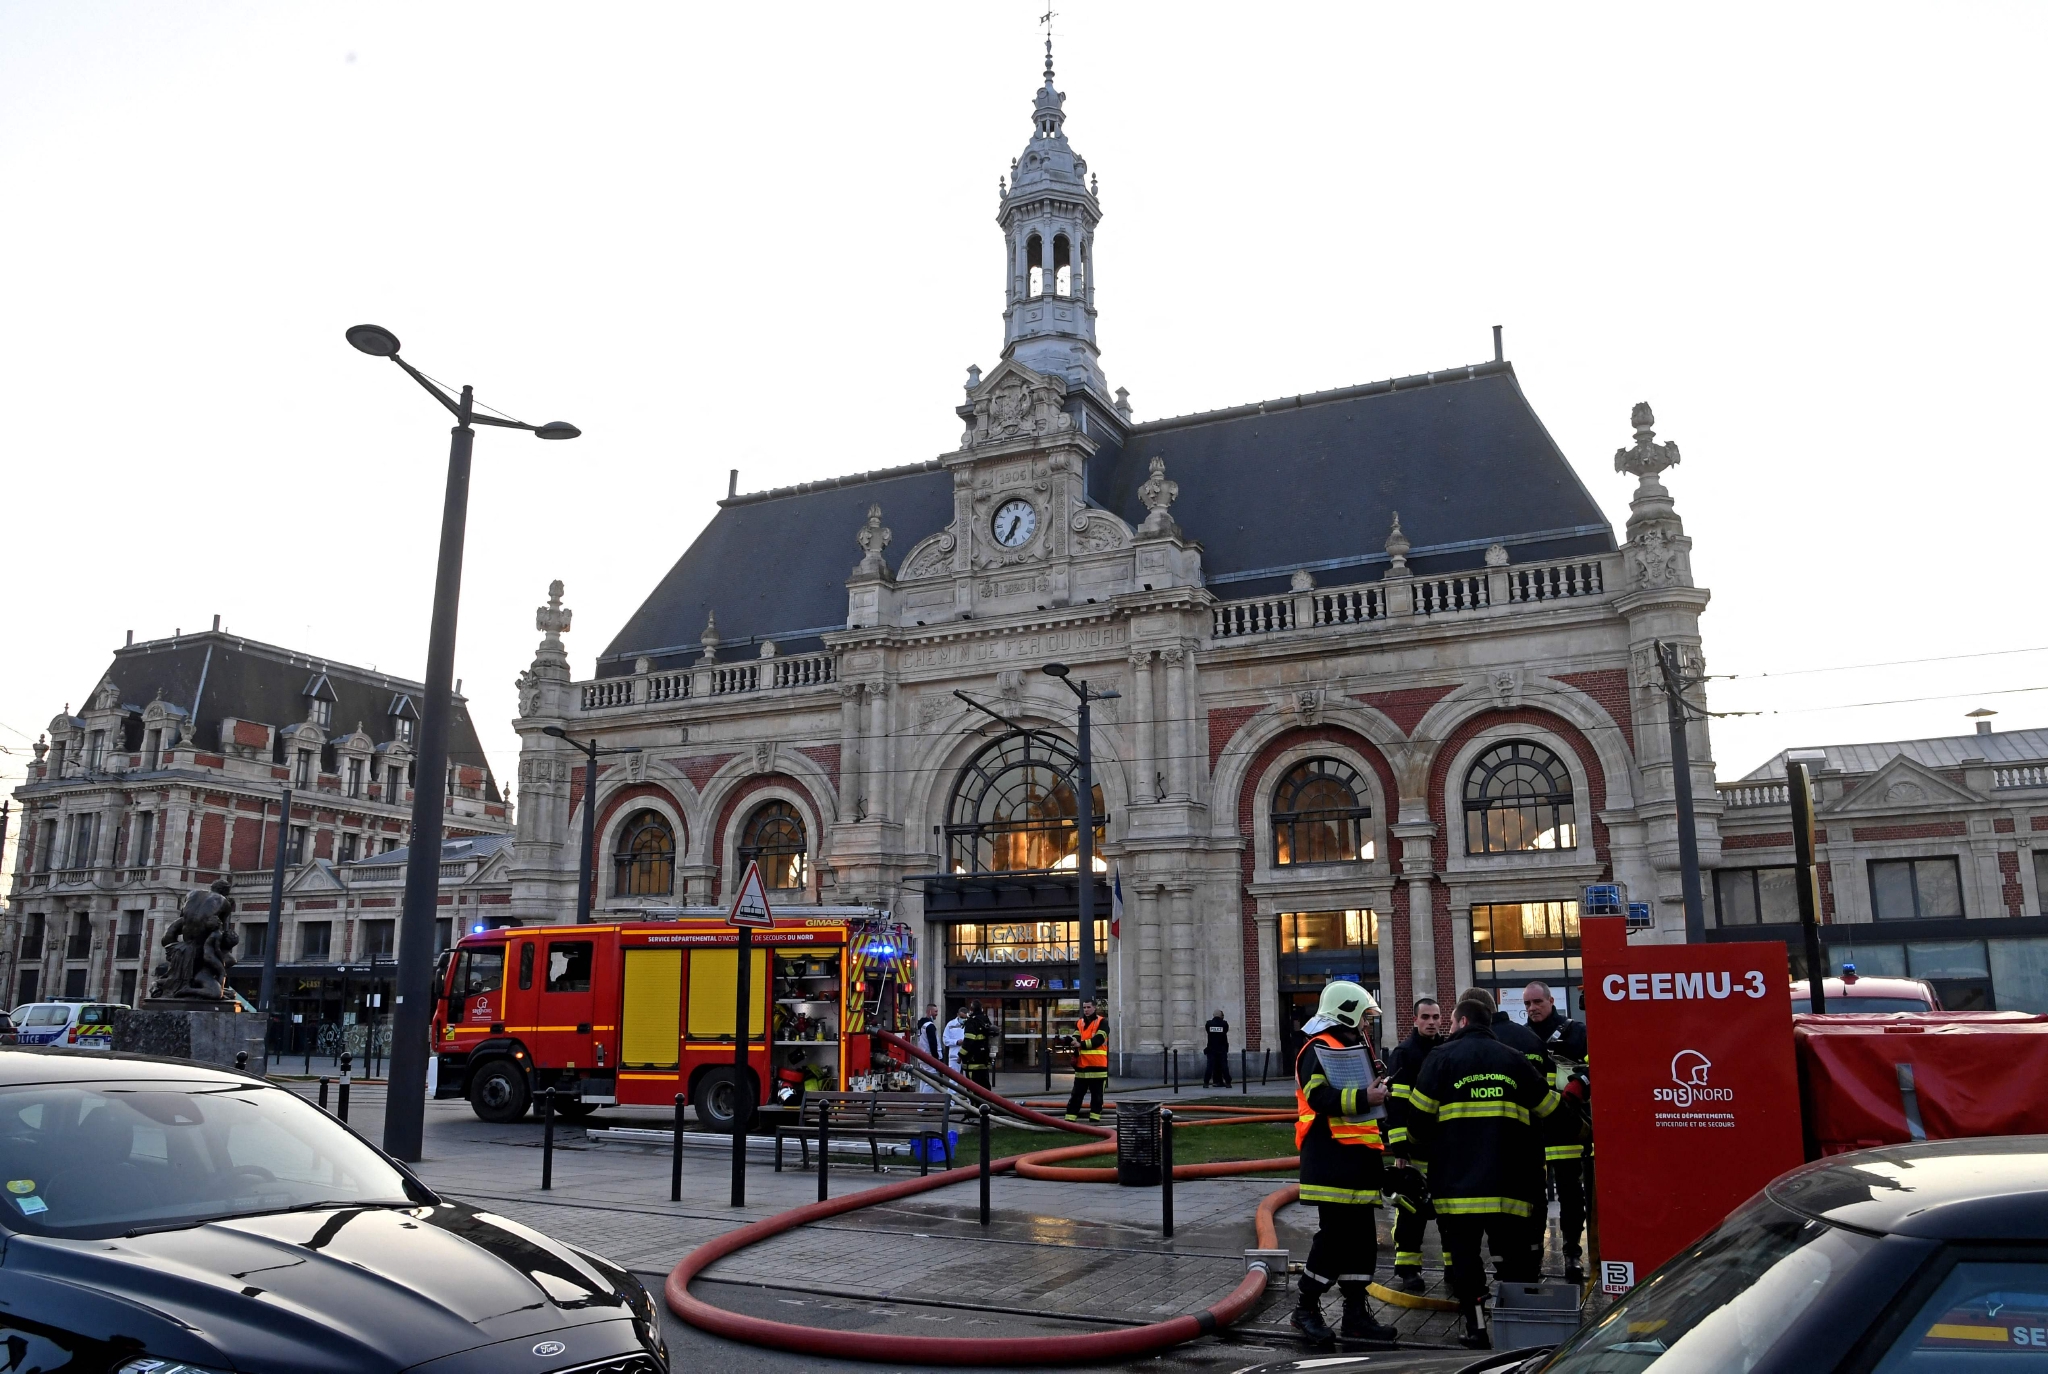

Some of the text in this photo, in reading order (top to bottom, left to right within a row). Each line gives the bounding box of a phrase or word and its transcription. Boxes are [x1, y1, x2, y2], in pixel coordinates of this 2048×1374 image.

[903, 626, 1126, 669] CHEMIN DE FER DU NORD
[805, 919, 845, 927] GIMAEX
[991, 923, 1062, 941] GARE DE
[671, 935, 718, 943] DÉPARTEMENTAL
[964, 946, 1080, 963] VALENCIENNE
[1015, 979, 1037, 988] SNCF
[1602, 970, 1767, 1001] CEEMU-3
[1471, 1086, 1504, 1098] NORD
[1693, 1088, 1734, 1101] NORD
[1682, 1111, 1735, 1119] DÉPARTEMENTAL
[540, 1344, 559, 1354] Ford
